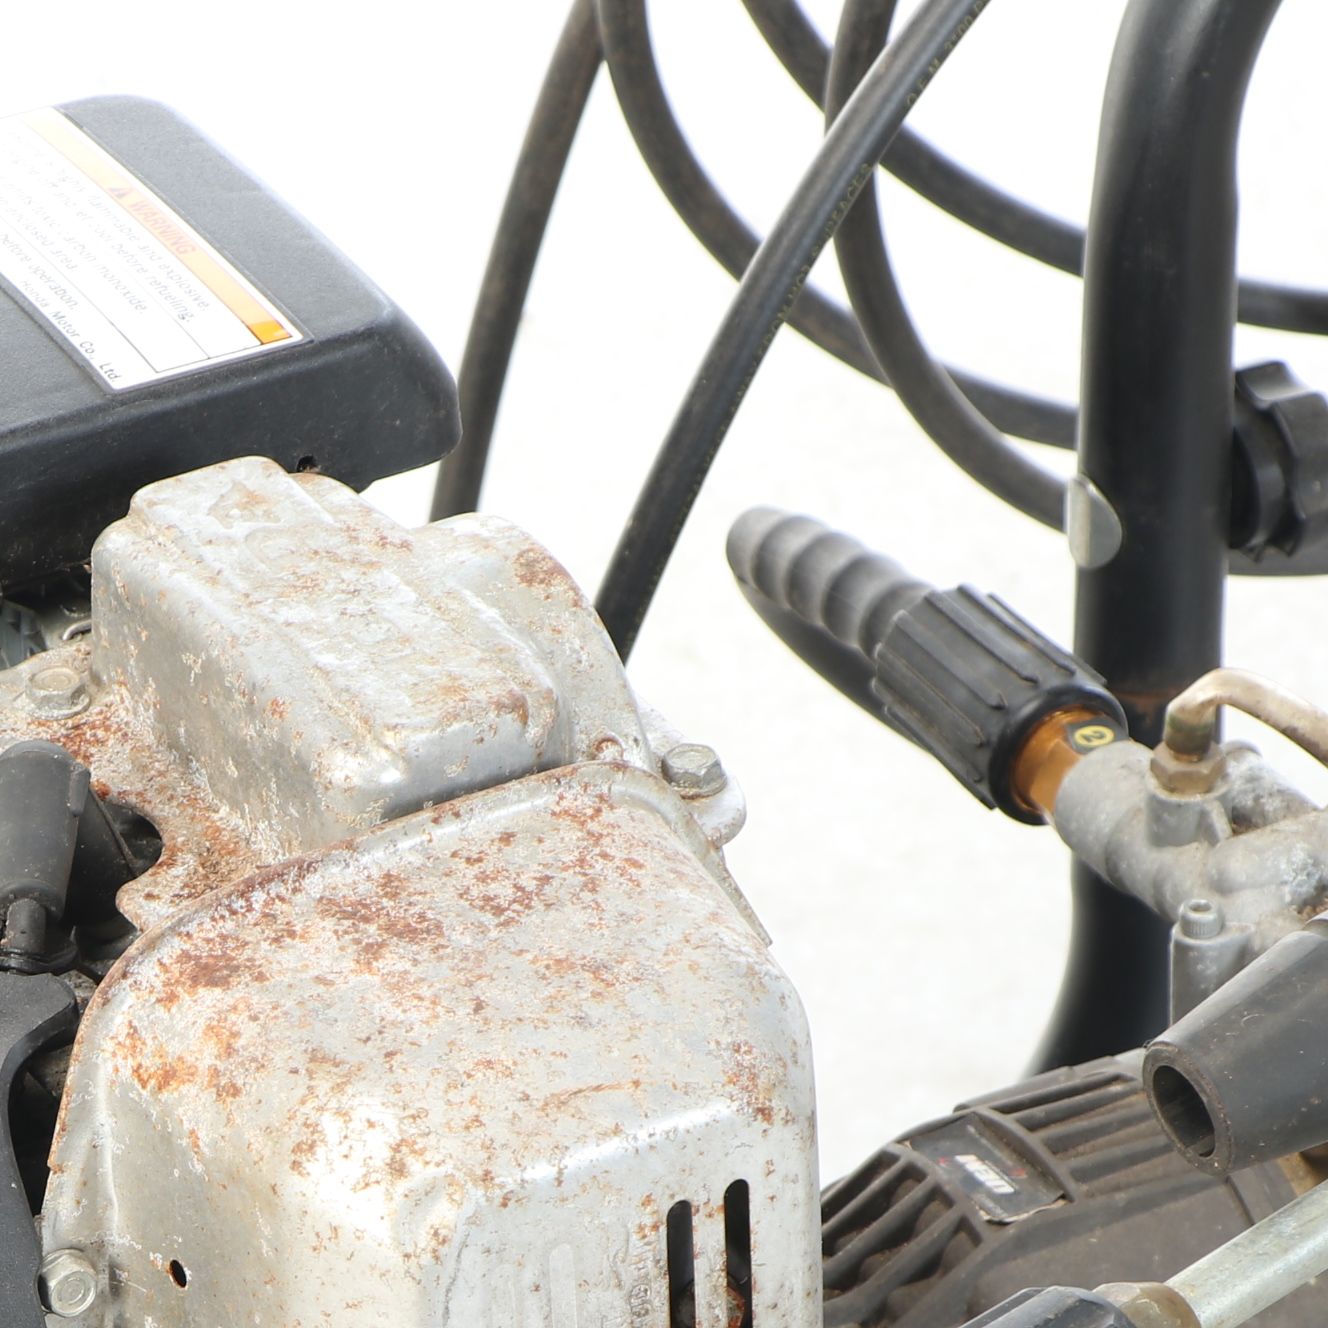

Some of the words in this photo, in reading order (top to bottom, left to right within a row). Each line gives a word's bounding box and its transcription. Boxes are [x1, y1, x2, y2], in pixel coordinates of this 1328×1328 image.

[129, 199, 198, 256] WARNING
[51, 308, 82, 339] Motor
[98, 362, 124, 384] Ltd.
